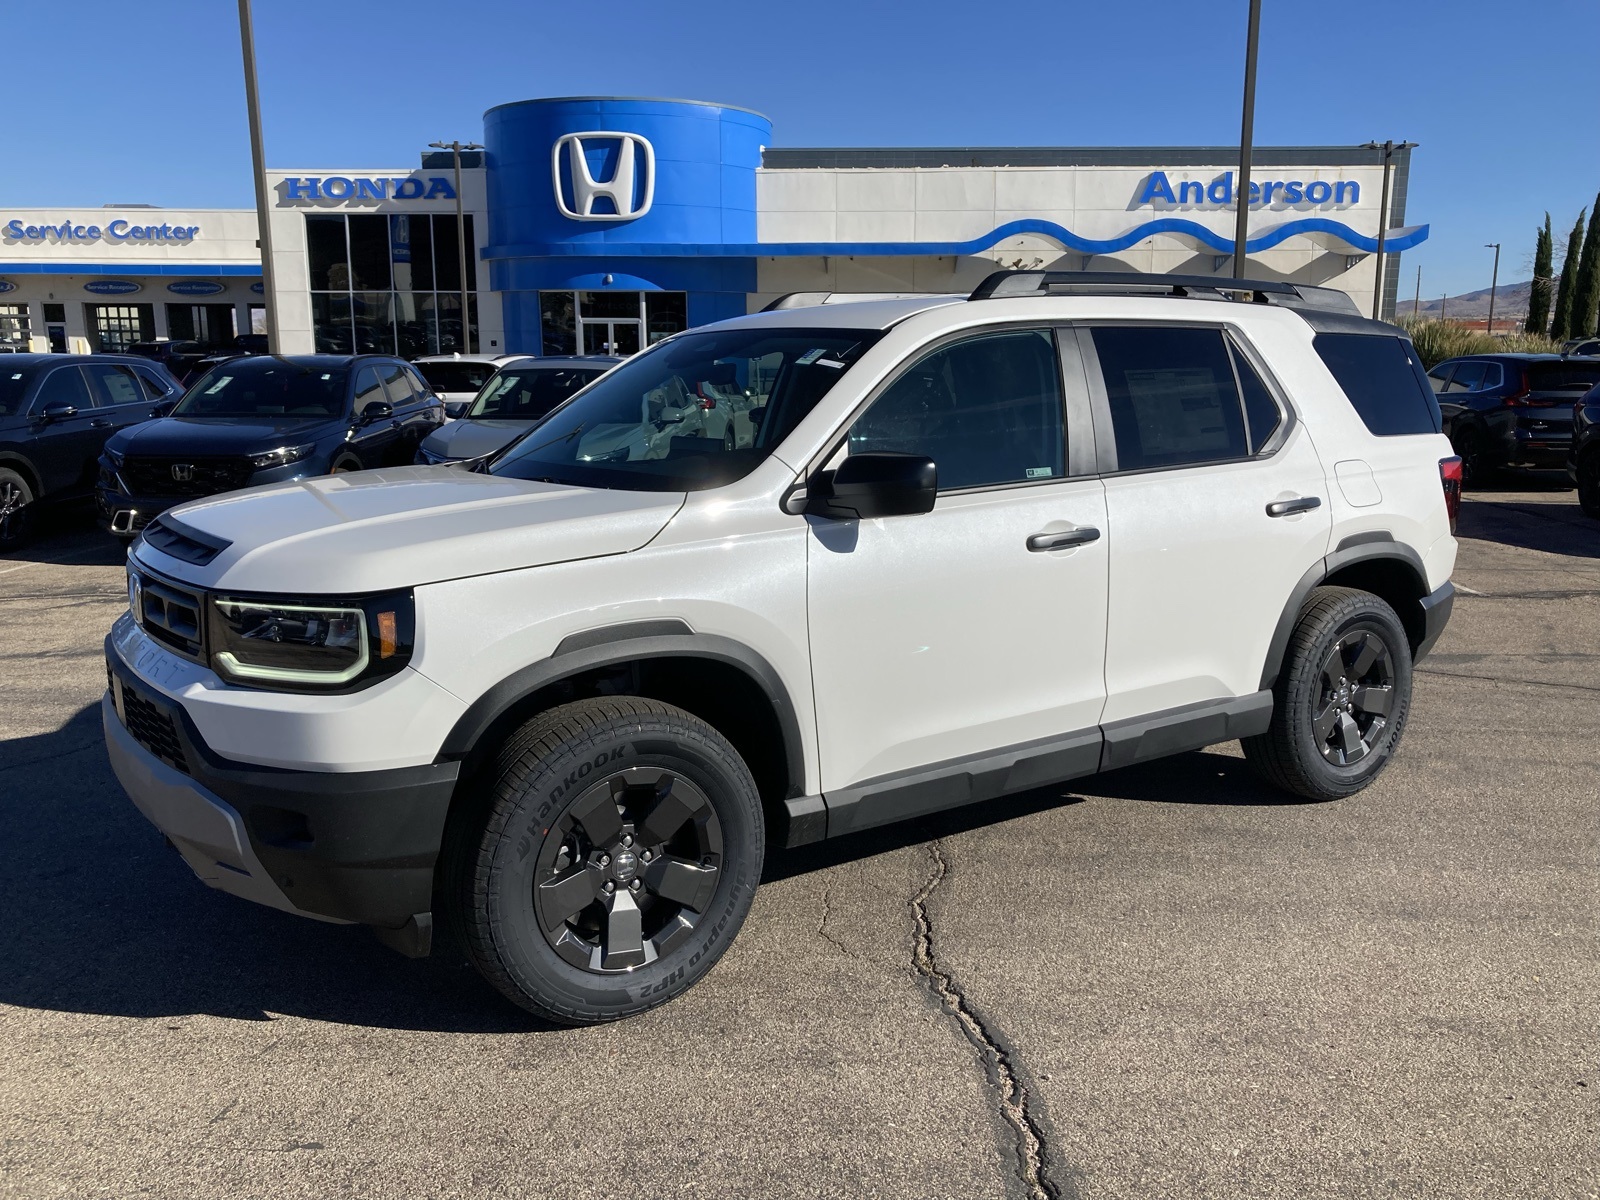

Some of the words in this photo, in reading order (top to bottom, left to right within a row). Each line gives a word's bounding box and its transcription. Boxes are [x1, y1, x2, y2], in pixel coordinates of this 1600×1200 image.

[284, 176, 457, 200] HONDA
[1138, 171, 1360, 204] Anderson
[8, 219, 101, 240] Service
[109, 219, 200, 240] Center
[640, 965, 685, 999] HP2
